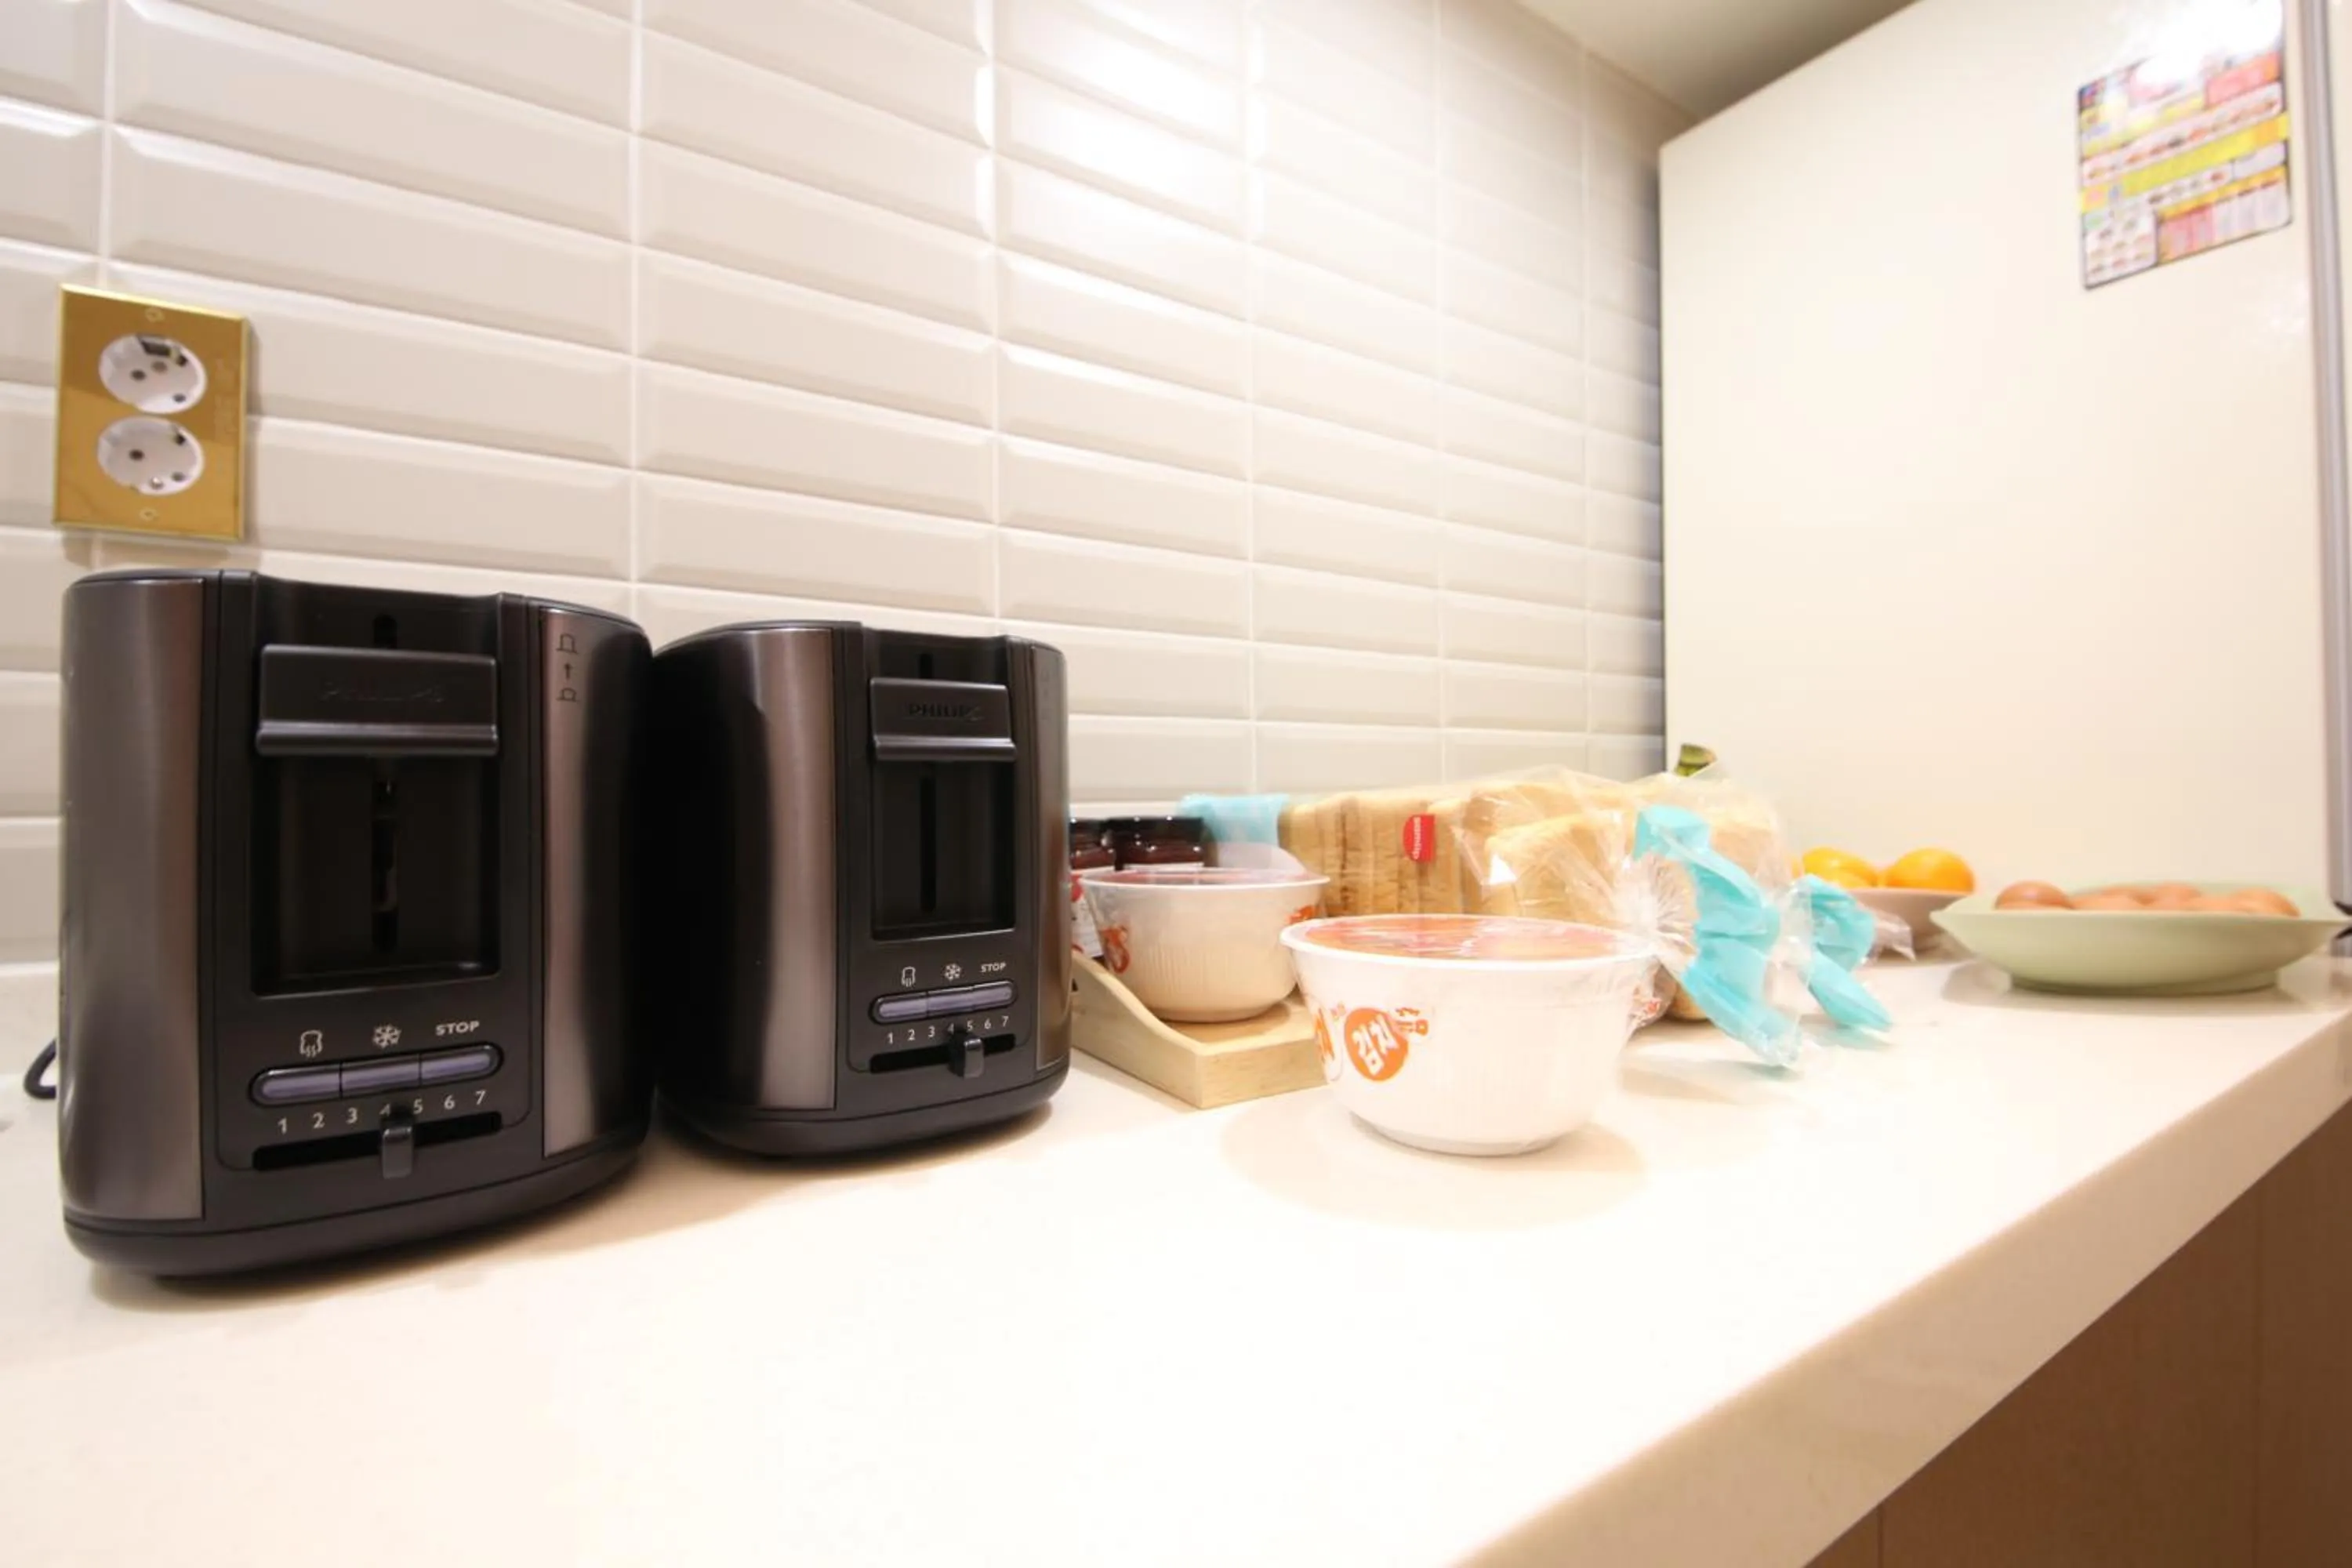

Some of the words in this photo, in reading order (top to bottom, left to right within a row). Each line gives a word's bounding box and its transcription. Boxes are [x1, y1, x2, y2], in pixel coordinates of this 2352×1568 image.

[981, 961, 1007, 973] STOP
[436, 1020, 480, 1036] STOP
[887, 1032, 894, 1044] 1
[907, 1029, 916, 1041] 2
[927, 1025, 935, 1038] 3
[967, 1020, 974, 1032] 5
[984, 1018, 992, 1029] 6
[1002, 1015, 1009, 1027] 7
[278, 1117, 288, 1134] 1
[313, 1112, 325, 1129] 2
[347, 1107, 358, 1124] 3
[412, 1098, 423, 1114] 5
[444, 1094, 456, 1110] 6
[475, 1090, 486, 1105] 7
